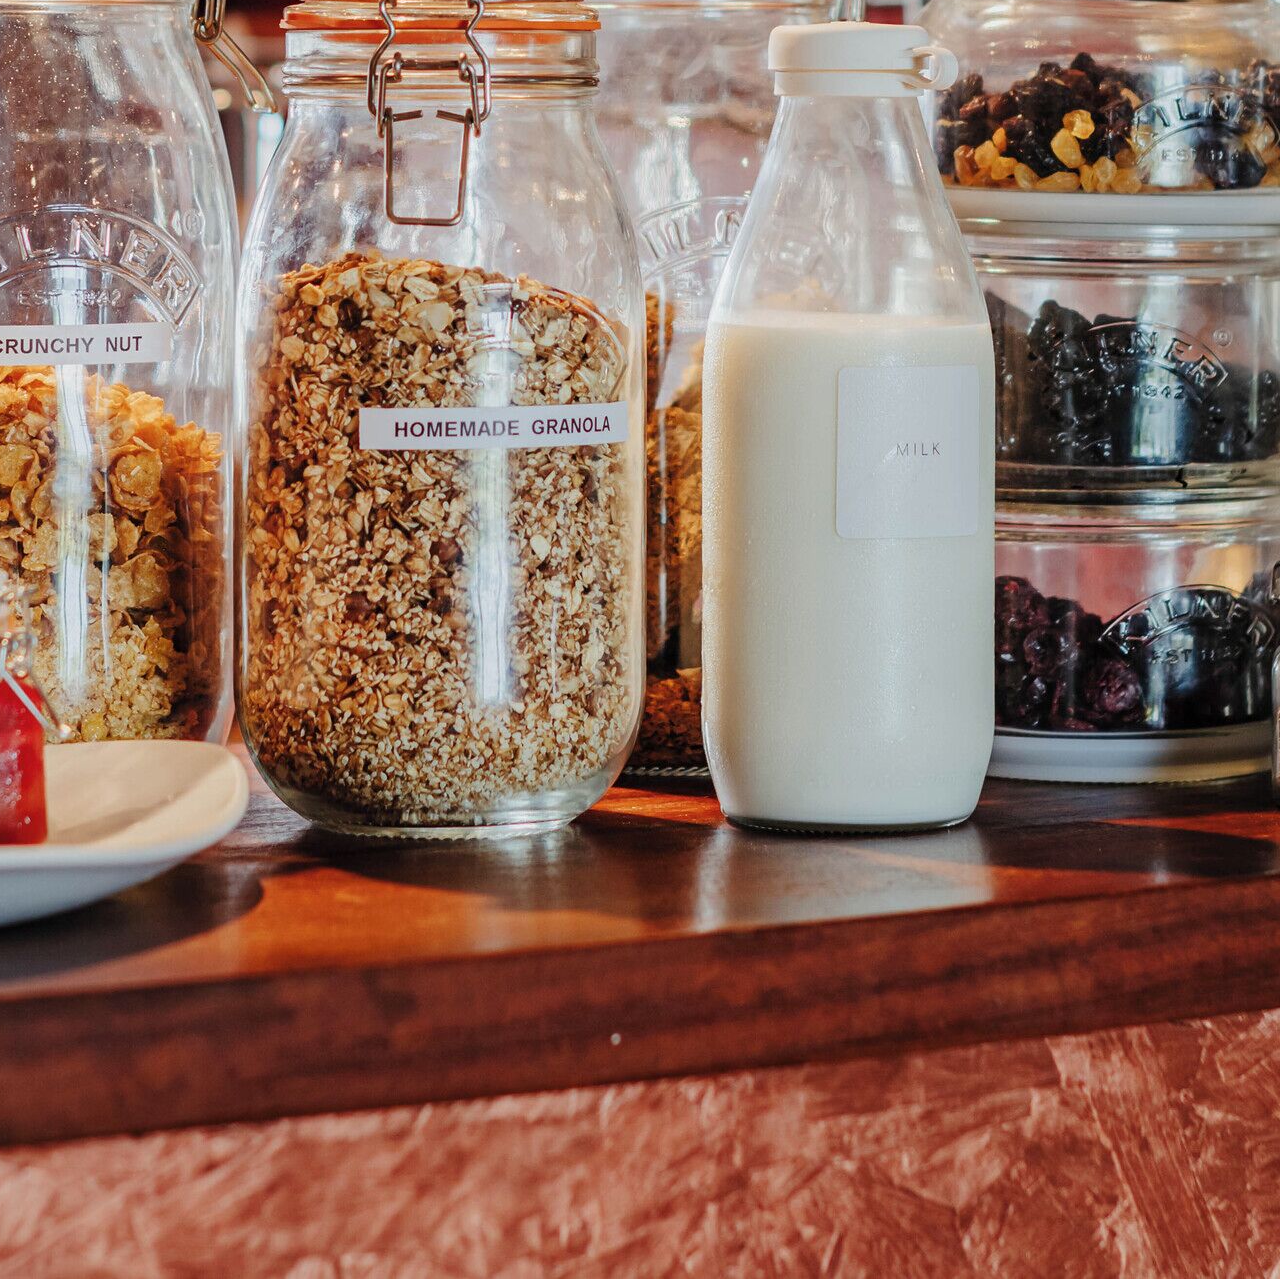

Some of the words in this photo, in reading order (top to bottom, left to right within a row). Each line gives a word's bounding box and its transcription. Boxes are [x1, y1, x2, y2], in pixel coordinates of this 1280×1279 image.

[105, 335, 143, 353] NUT
[394, 419, 520, 438] HOMEMADE
[531, 416, 611, 435] GRANOLA
[896, 442, 941, 457] MILK
